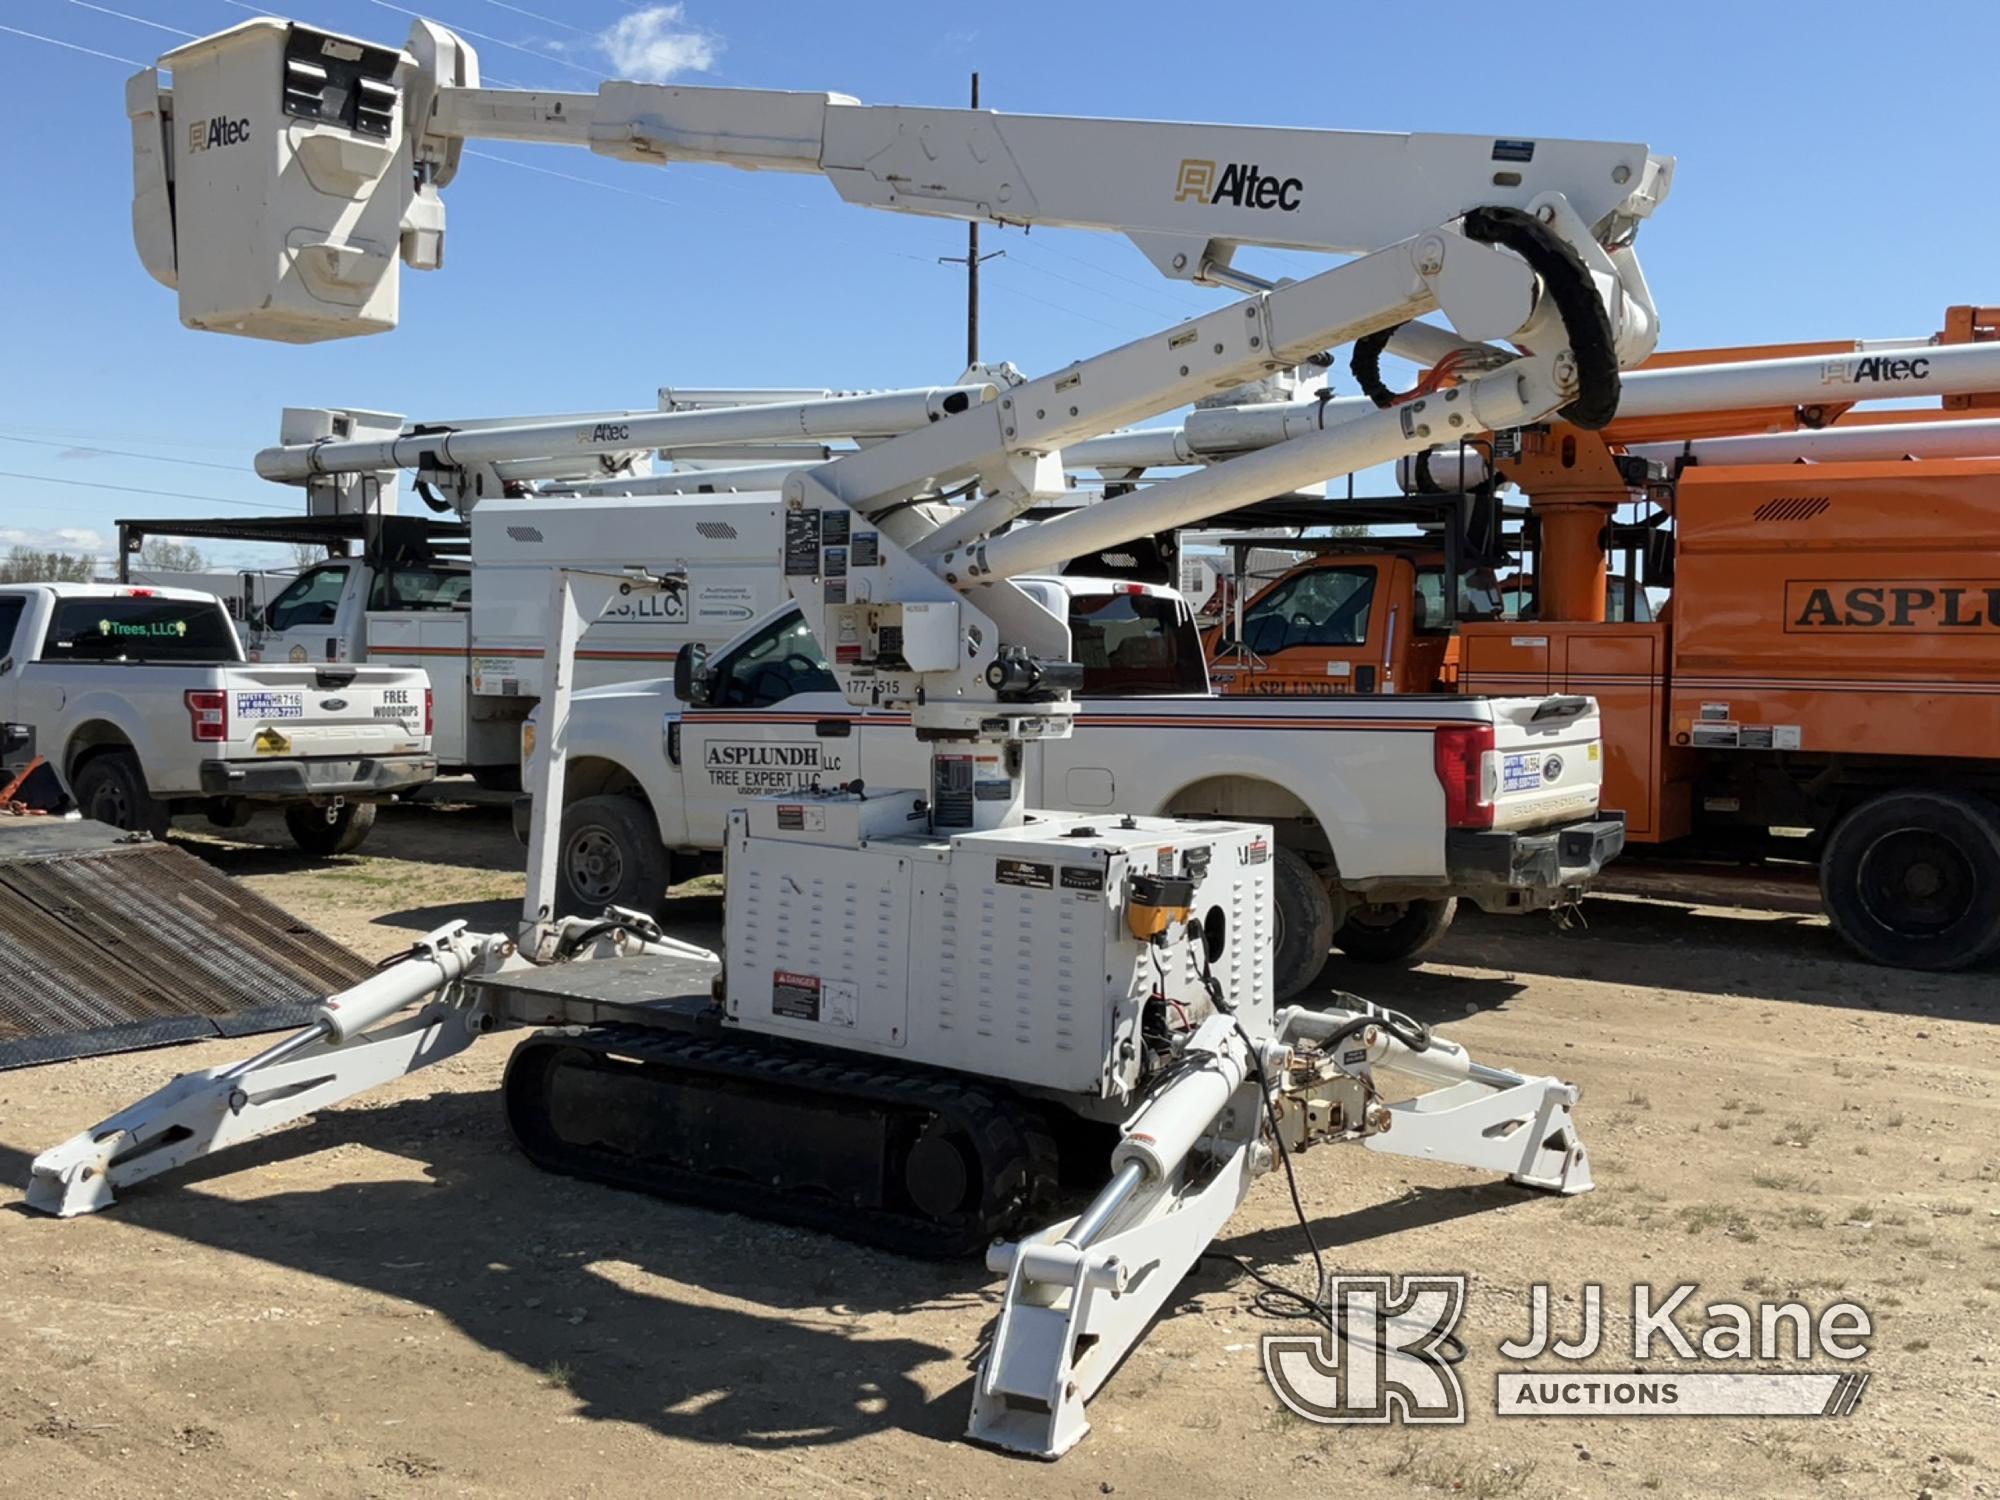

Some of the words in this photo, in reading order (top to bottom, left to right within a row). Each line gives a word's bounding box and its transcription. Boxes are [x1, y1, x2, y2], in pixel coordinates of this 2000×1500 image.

[206, 115, 250, 150] Altec
[1210, 163, 1304, 212] Altec
[1853, 356, 1930, 383] Altec
[593, 423, 630, 443] Altec
[110, 621, 150, 637] Trees,
[151, 622, 177, 636] LLC
[383, 690, 408, 704] FREE
[706, 746, 819, 767] ASPLUNDH
[823, 756, 842, 771] LLC
[708, 770, 739, 786] TREE
[744, 771, 794, 787] EXPERT
[785, 974, 816, 988] DANGER
